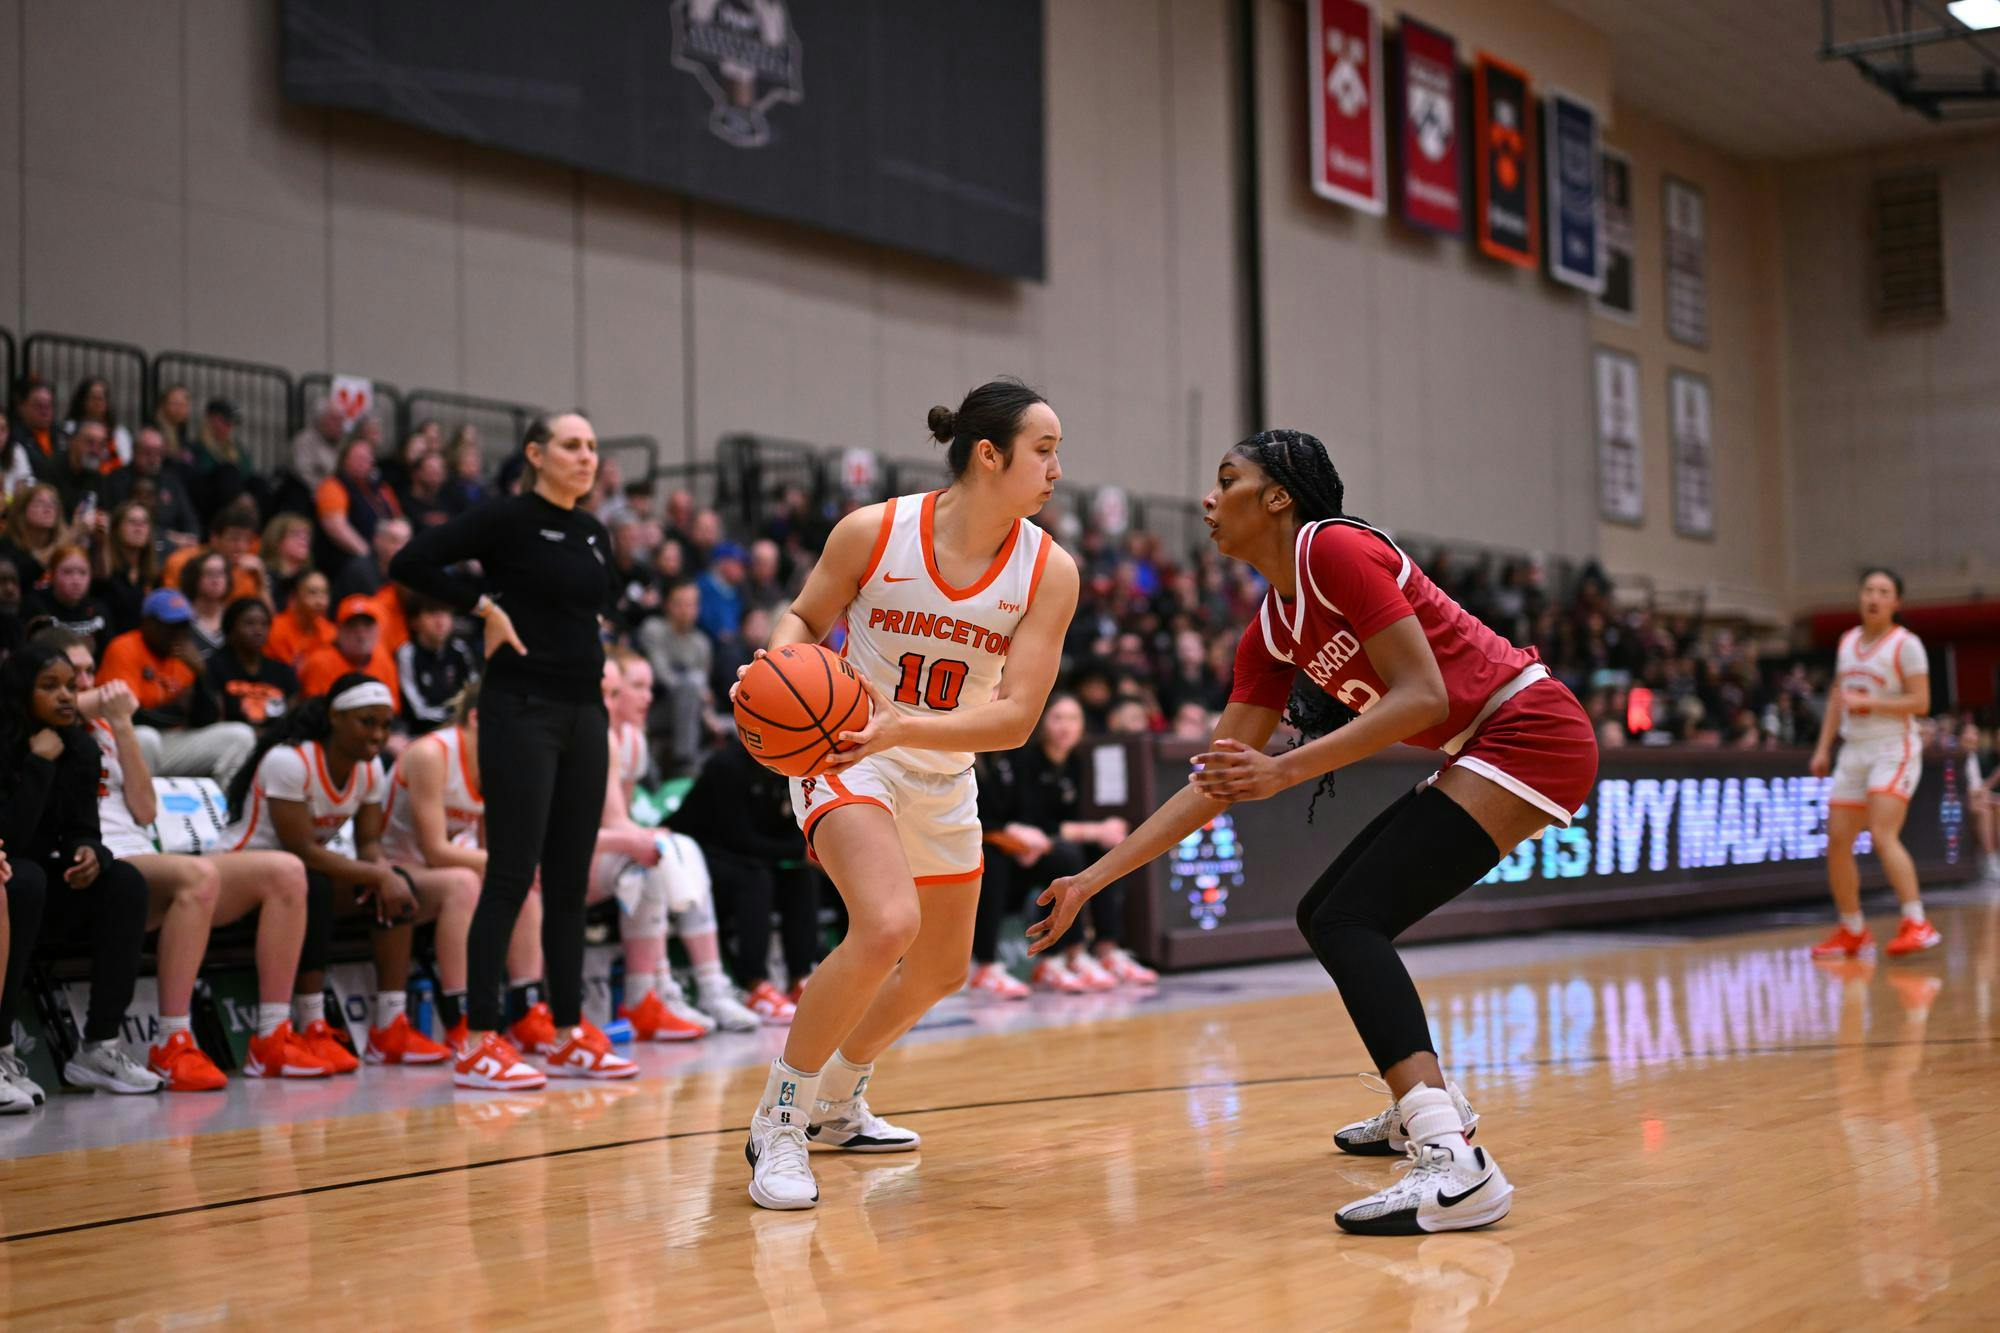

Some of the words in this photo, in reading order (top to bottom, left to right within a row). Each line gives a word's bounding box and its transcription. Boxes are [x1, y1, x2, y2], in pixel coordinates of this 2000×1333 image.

[868, 608, 1013, 656] PRINCETON
[894, 652, 969, 711] 10
[1596, 779, 1679, 875] IVY
[1678, 776, 1872, 869] MADNE
[121, 1014, 160, 1044] TIA
